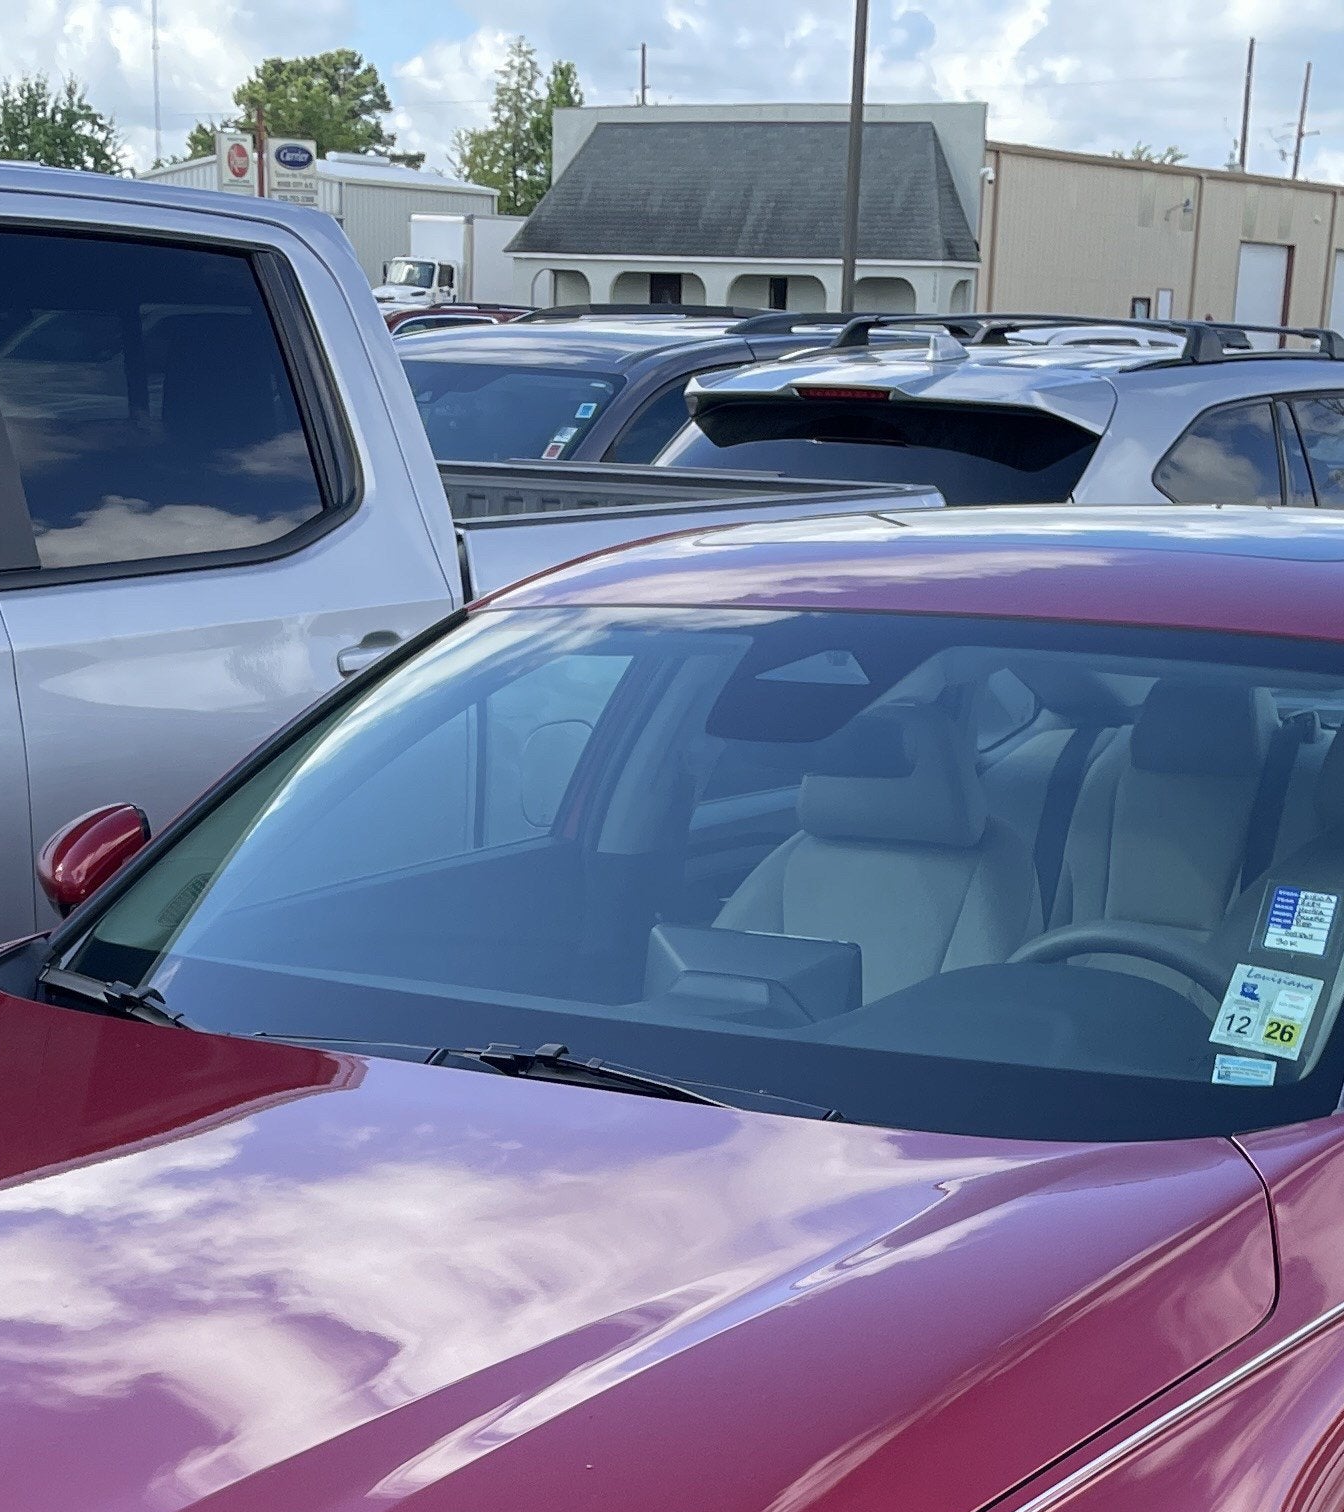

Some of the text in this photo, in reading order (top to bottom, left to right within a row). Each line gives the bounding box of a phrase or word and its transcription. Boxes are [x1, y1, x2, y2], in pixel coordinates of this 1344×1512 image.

[1246, 967, 1314, 991] Louisiana
[1225, 1013, 1296, 1043] 12 26
